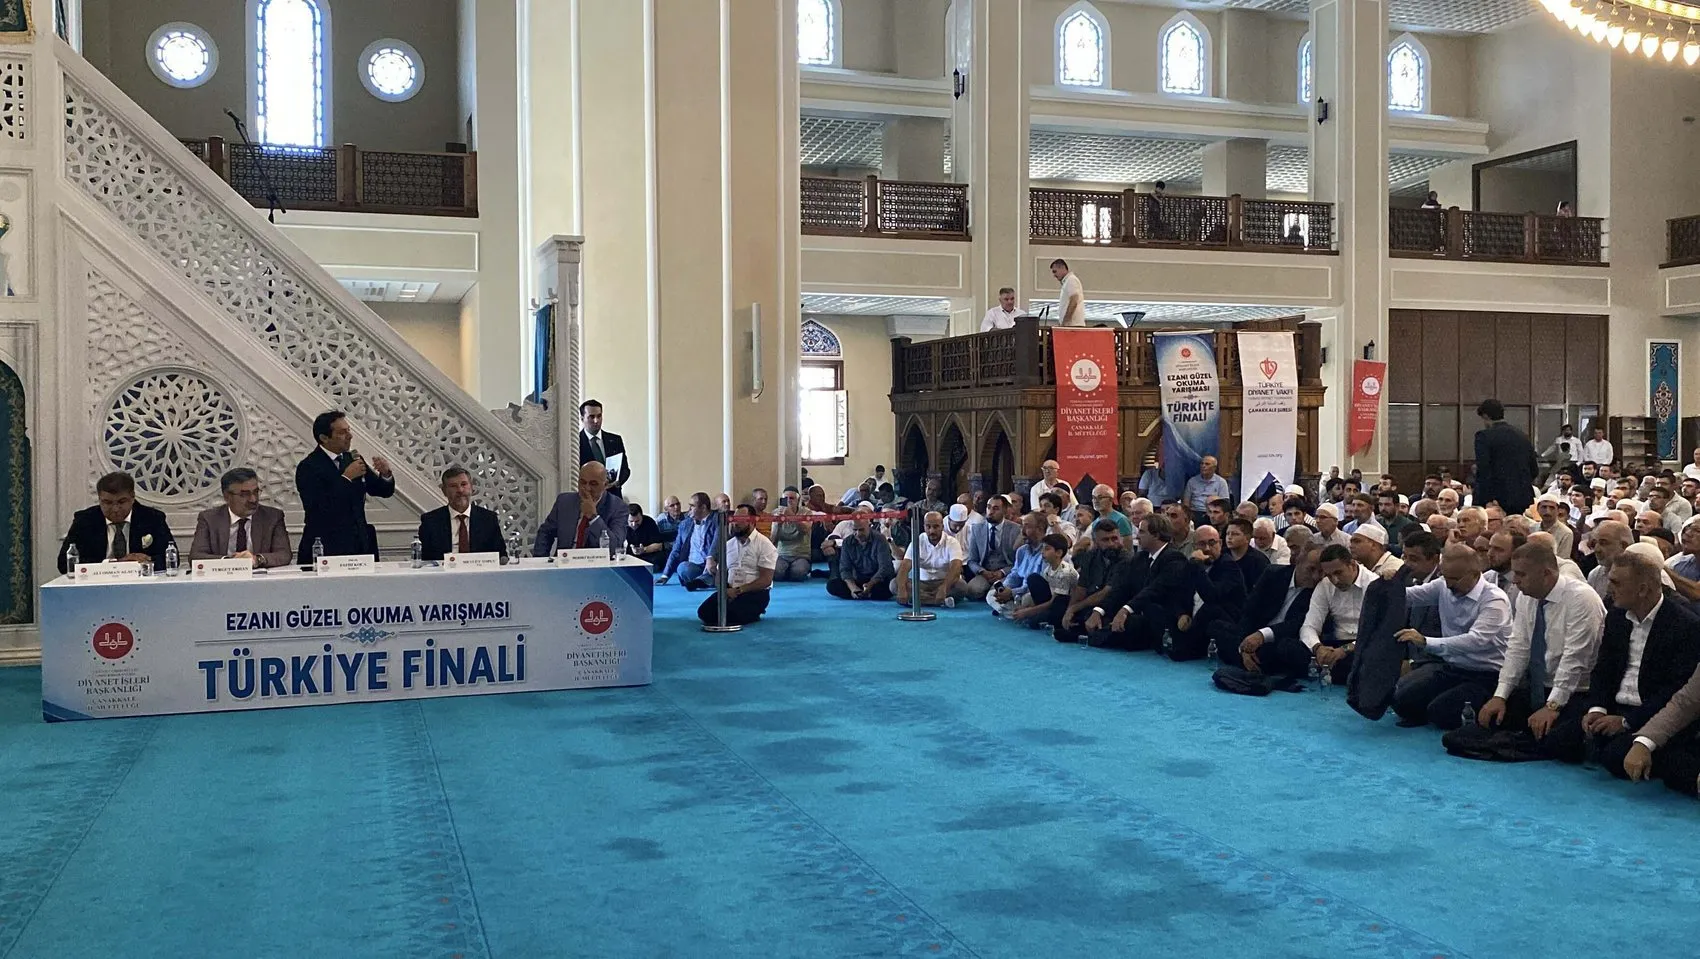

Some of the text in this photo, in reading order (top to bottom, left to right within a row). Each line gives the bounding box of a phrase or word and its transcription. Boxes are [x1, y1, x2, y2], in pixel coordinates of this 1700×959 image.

[1060, 406, 1113, 415] DİYANET İŞLERİ
[1167, 400, 1214, 412] TÜRKİYE
[1067, 414, 1108, 423] BAŞKANLIĞI
[1173, 411, 1206, 422] FİNALİ
[226, 601, 510, 631] EZANI GÜZEL OKUMA YARIŞMASI
[567, 651, 600, 660] DİYANET
[199, 634, 526, 700] TÜRKİYE FİNALİ
[573, 658, 620, 666] BAŞKANLIĞI
[77, 678, 119, 687] DİYANET
[121, 675, 150, 685] İŞLERİ
[86, 684, 142, 695] BAŞKANLIĞI
